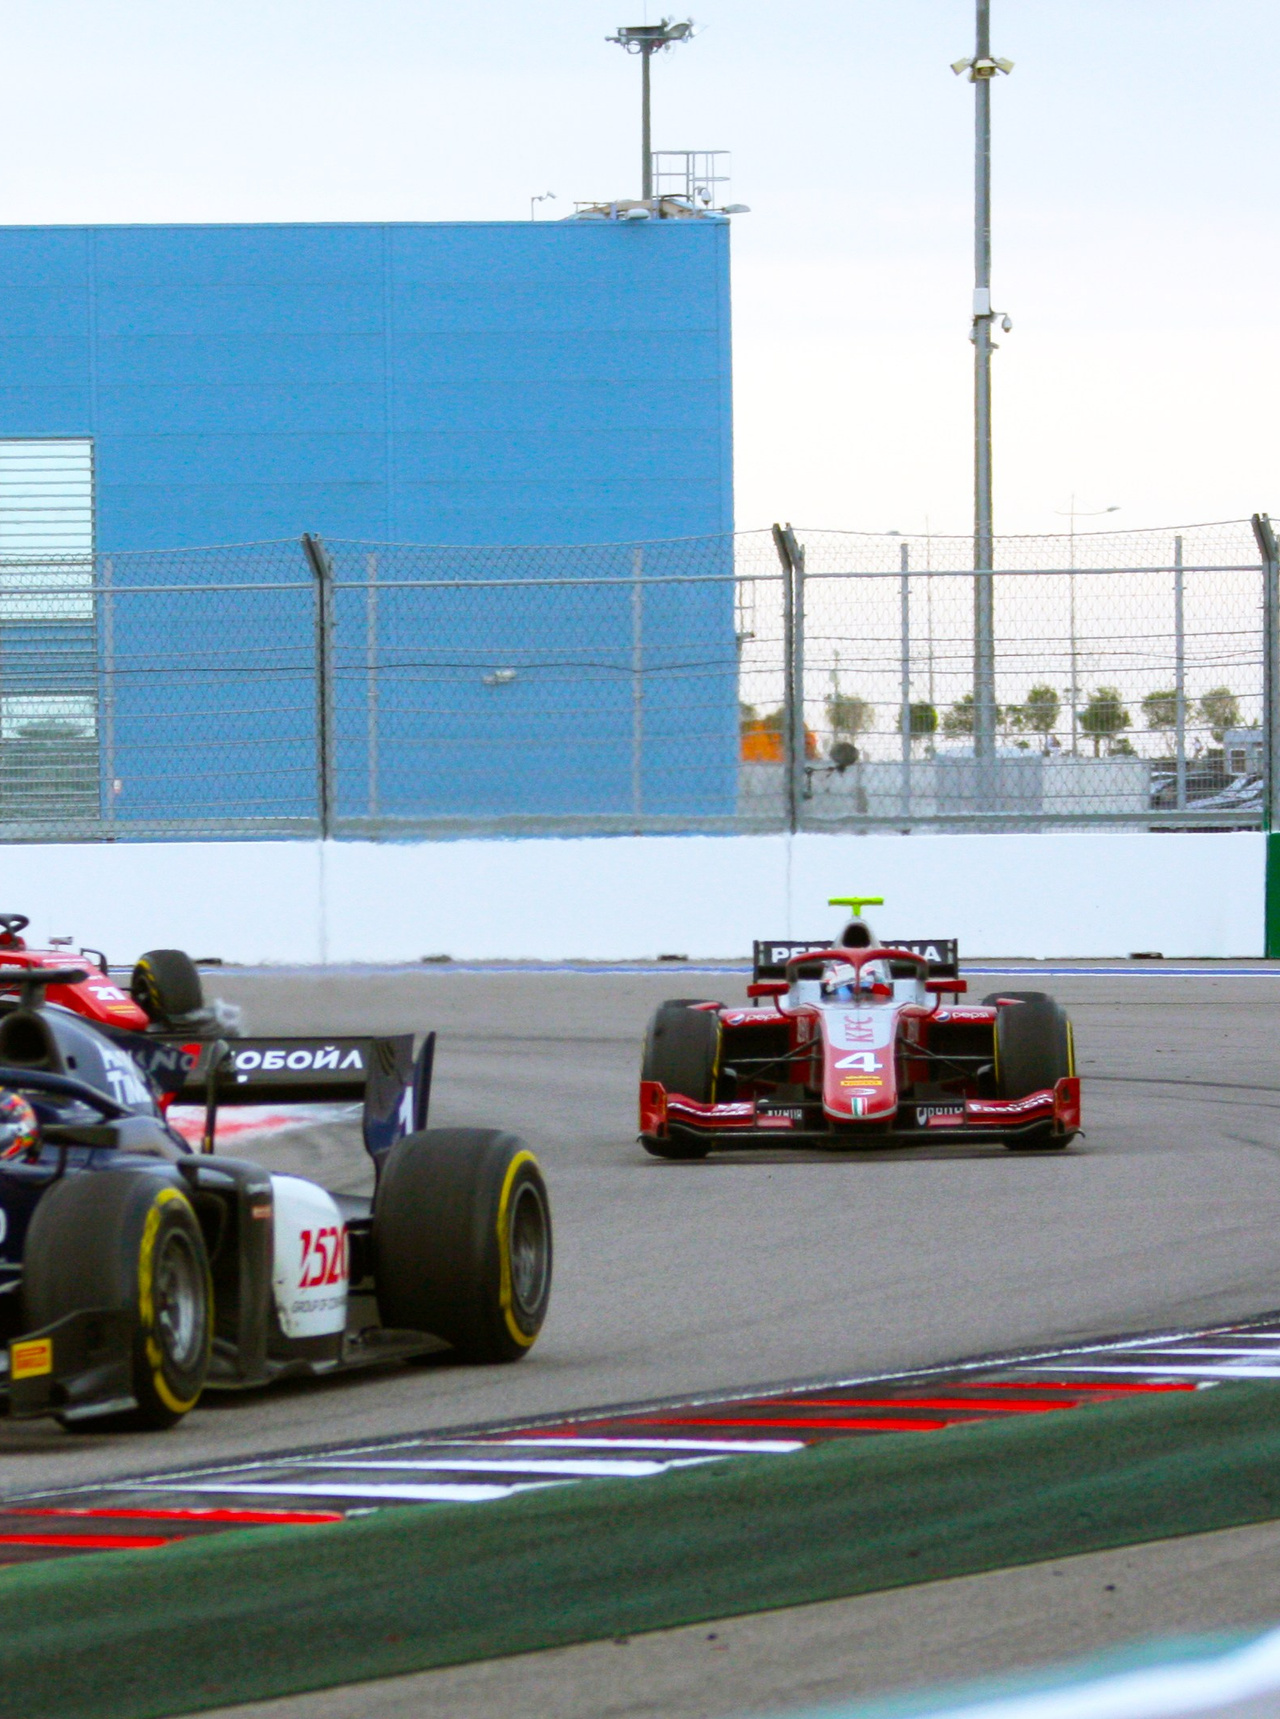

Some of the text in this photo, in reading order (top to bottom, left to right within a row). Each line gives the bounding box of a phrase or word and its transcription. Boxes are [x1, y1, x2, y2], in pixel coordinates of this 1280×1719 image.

[88, 986, 126, 1001] 21
[951, 1011, 990, 1020] pepsi
[843, 1015, 874, 1043] KFC
[231, 1046, 363, 1069] ОБОЙЛ
[834, 1051, 884, 1073] 4
[399, 1085, 413, 1135] 1
